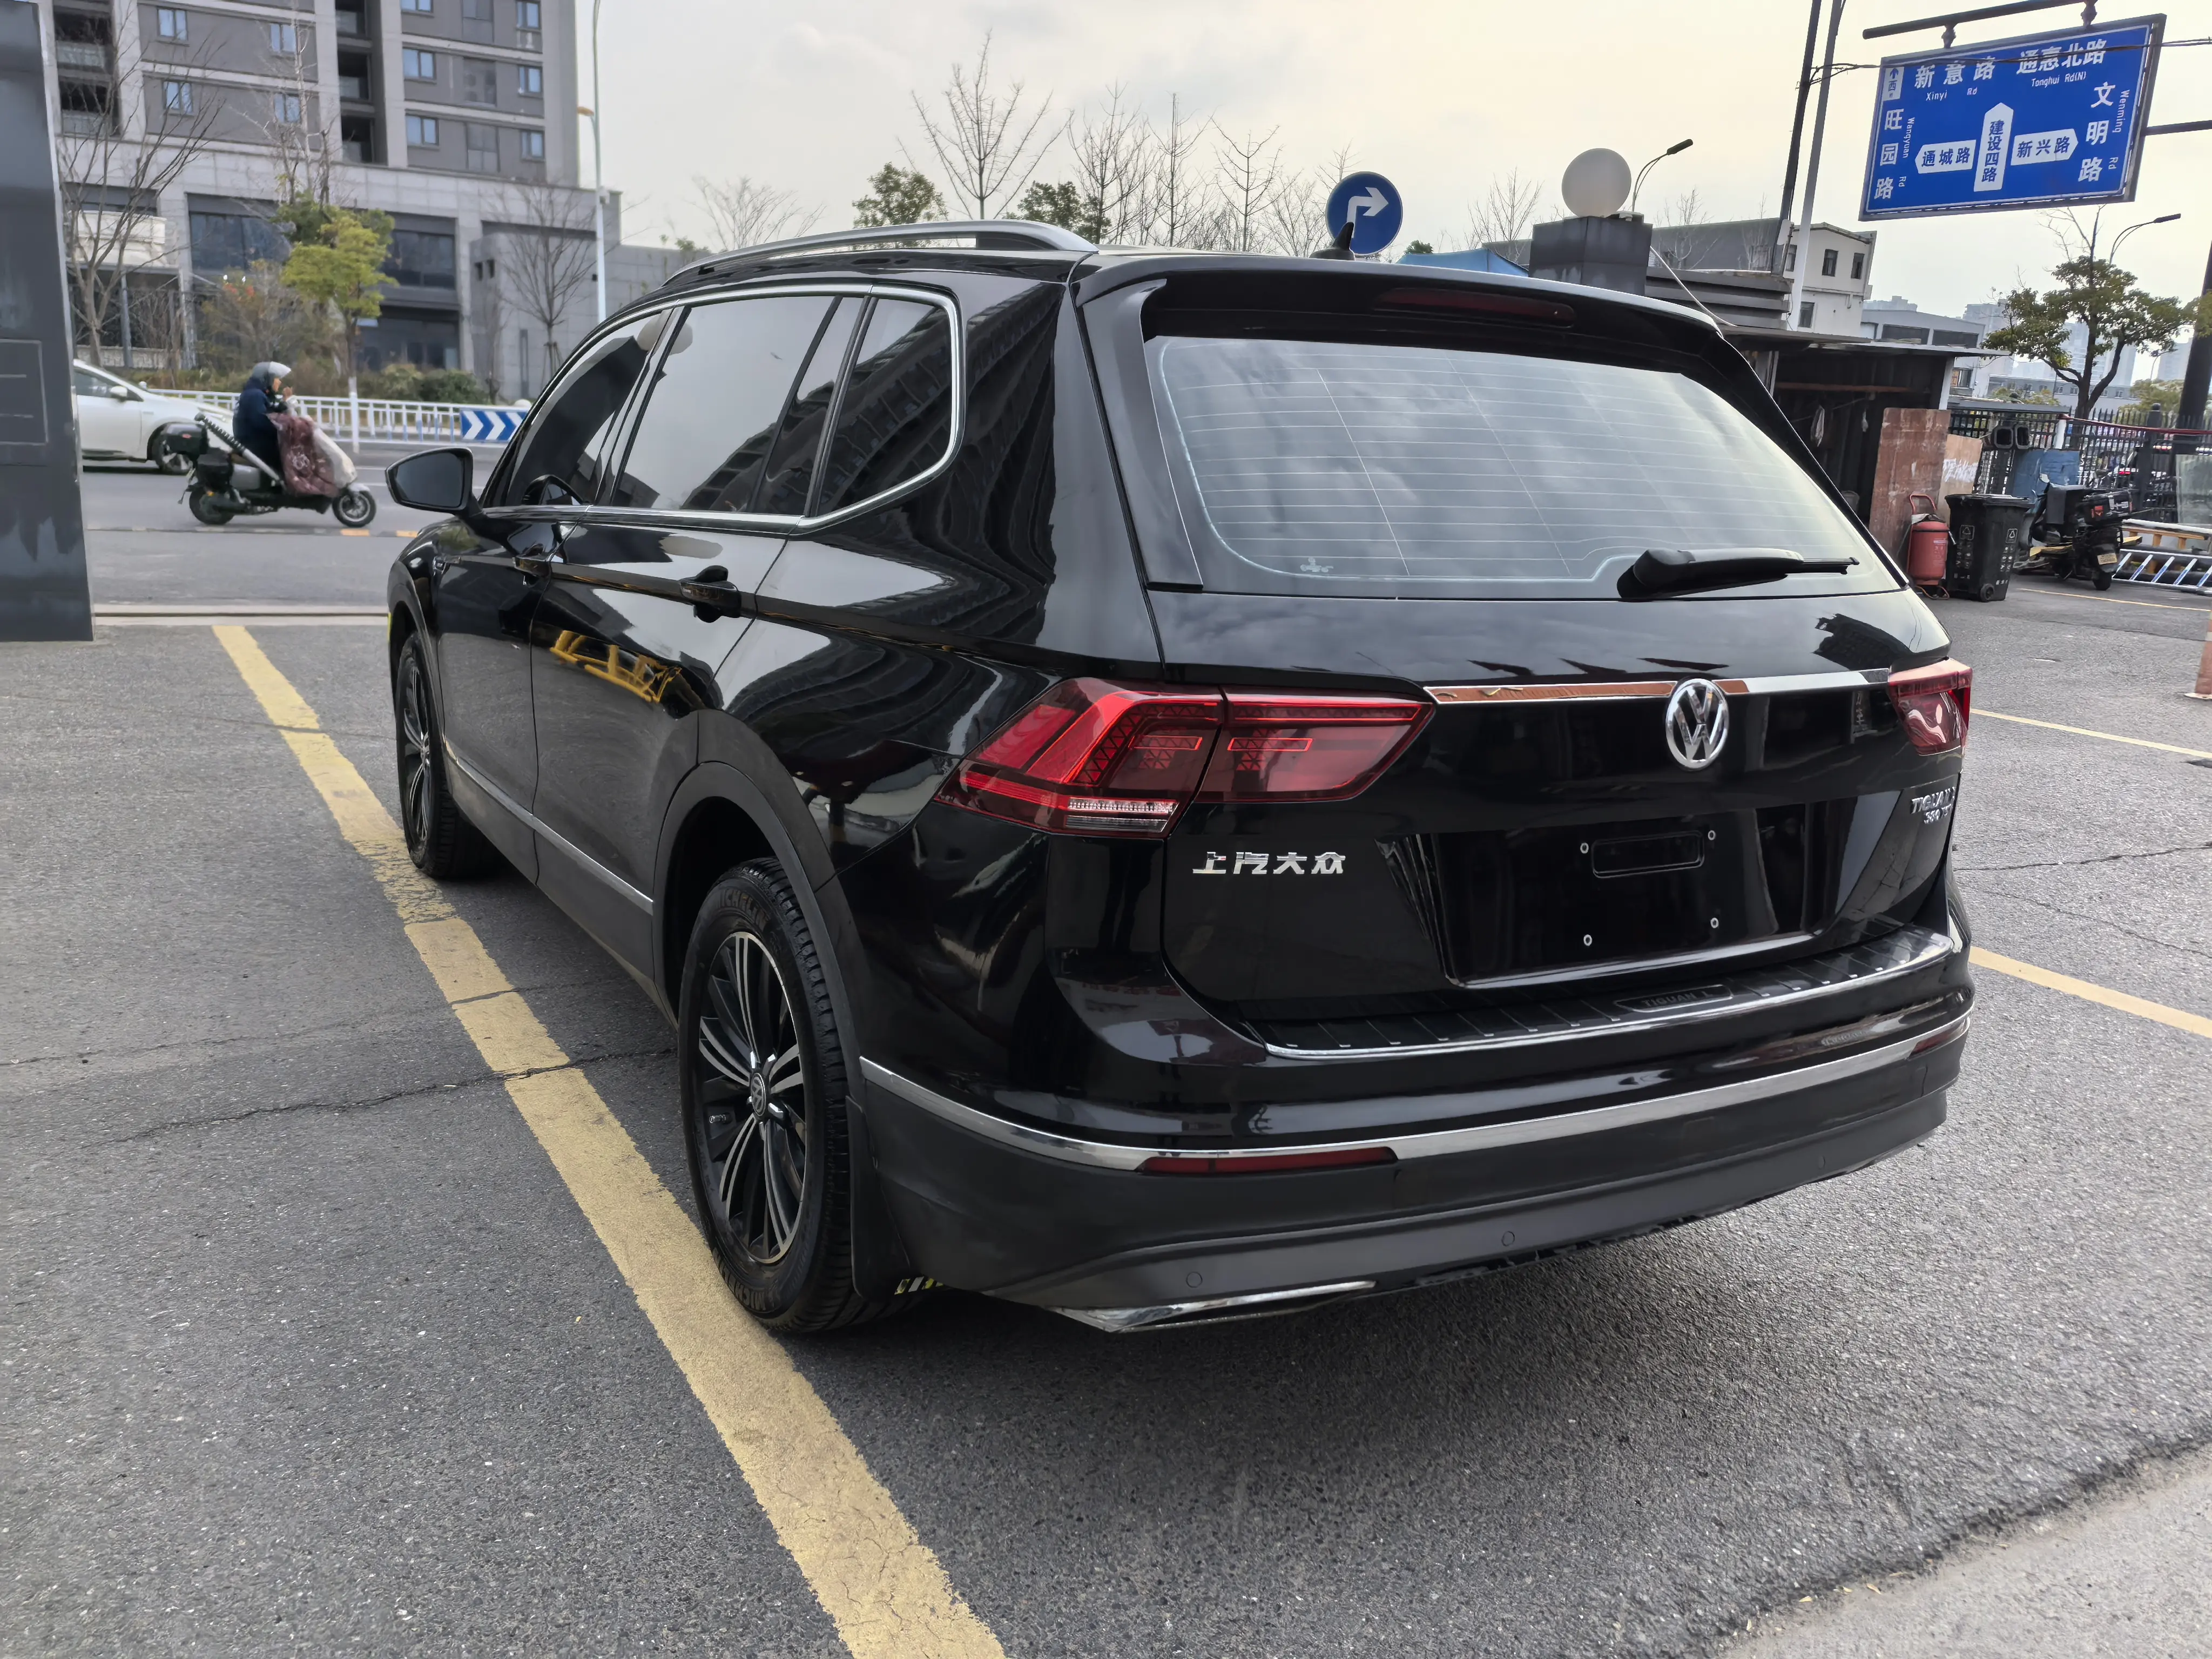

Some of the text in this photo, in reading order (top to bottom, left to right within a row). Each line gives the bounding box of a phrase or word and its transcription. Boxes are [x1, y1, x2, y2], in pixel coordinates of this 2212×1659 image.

[1914, 56, 1995, 89] 新意路
[2016, 39, 2107, 75] 通惠北路
[1926, 87, 1978, 101] Xinyi Rd
[2031, 71, 2086, 88] Tonghui Rd(N)
[2078, 81, 2116, 182] 文明路
[2108, 89, 2130, 170] Wenming Rd
[1874, 109, 1904, 199] 旺园路
[1898, 117, 1915, 187] Wangyuan Rd
[1921, 146, 1971, 167] 通城路
[1981, 119, 2005, 183] 建设四路
[2017, 136, 2071, 158] 新兴路
[1192, 851, 1346, 875] 上汽大众
[1641, 992, 1697, 1007] TIGUAN
